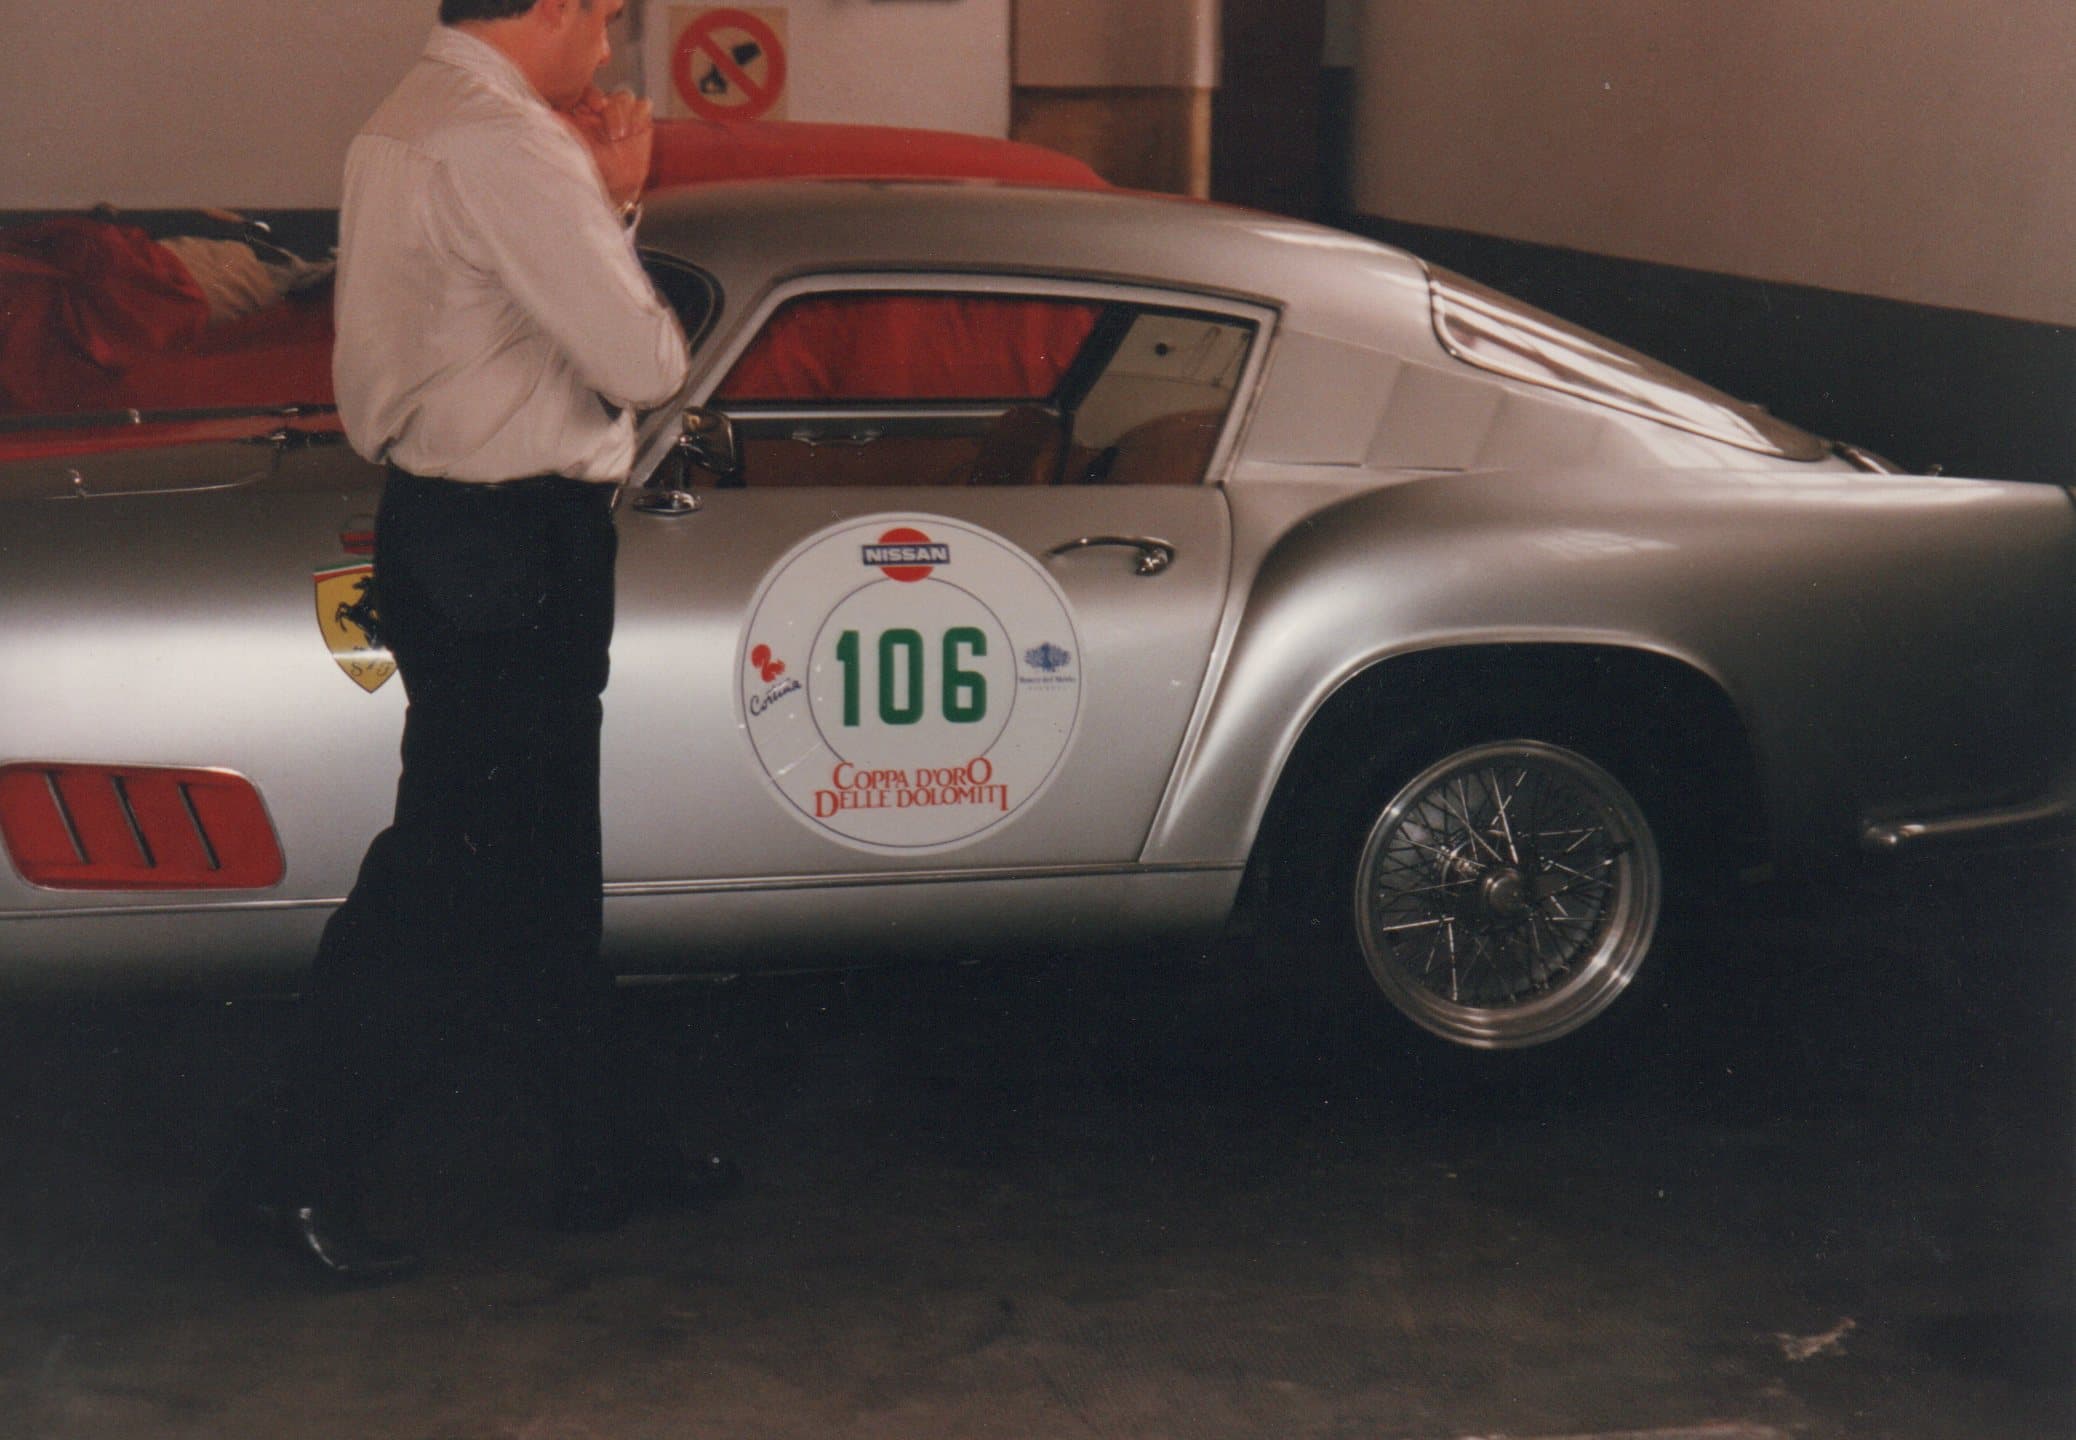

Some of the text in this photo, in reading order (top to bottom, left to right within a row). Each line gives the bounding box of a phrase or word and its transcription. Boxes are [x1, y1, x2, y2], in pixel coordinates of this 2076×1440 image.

[865, 546, 947, 562] NISSAN
[836, 627, 987, 727] 106
[896, 783, 1009, 812] DOLOMITI
